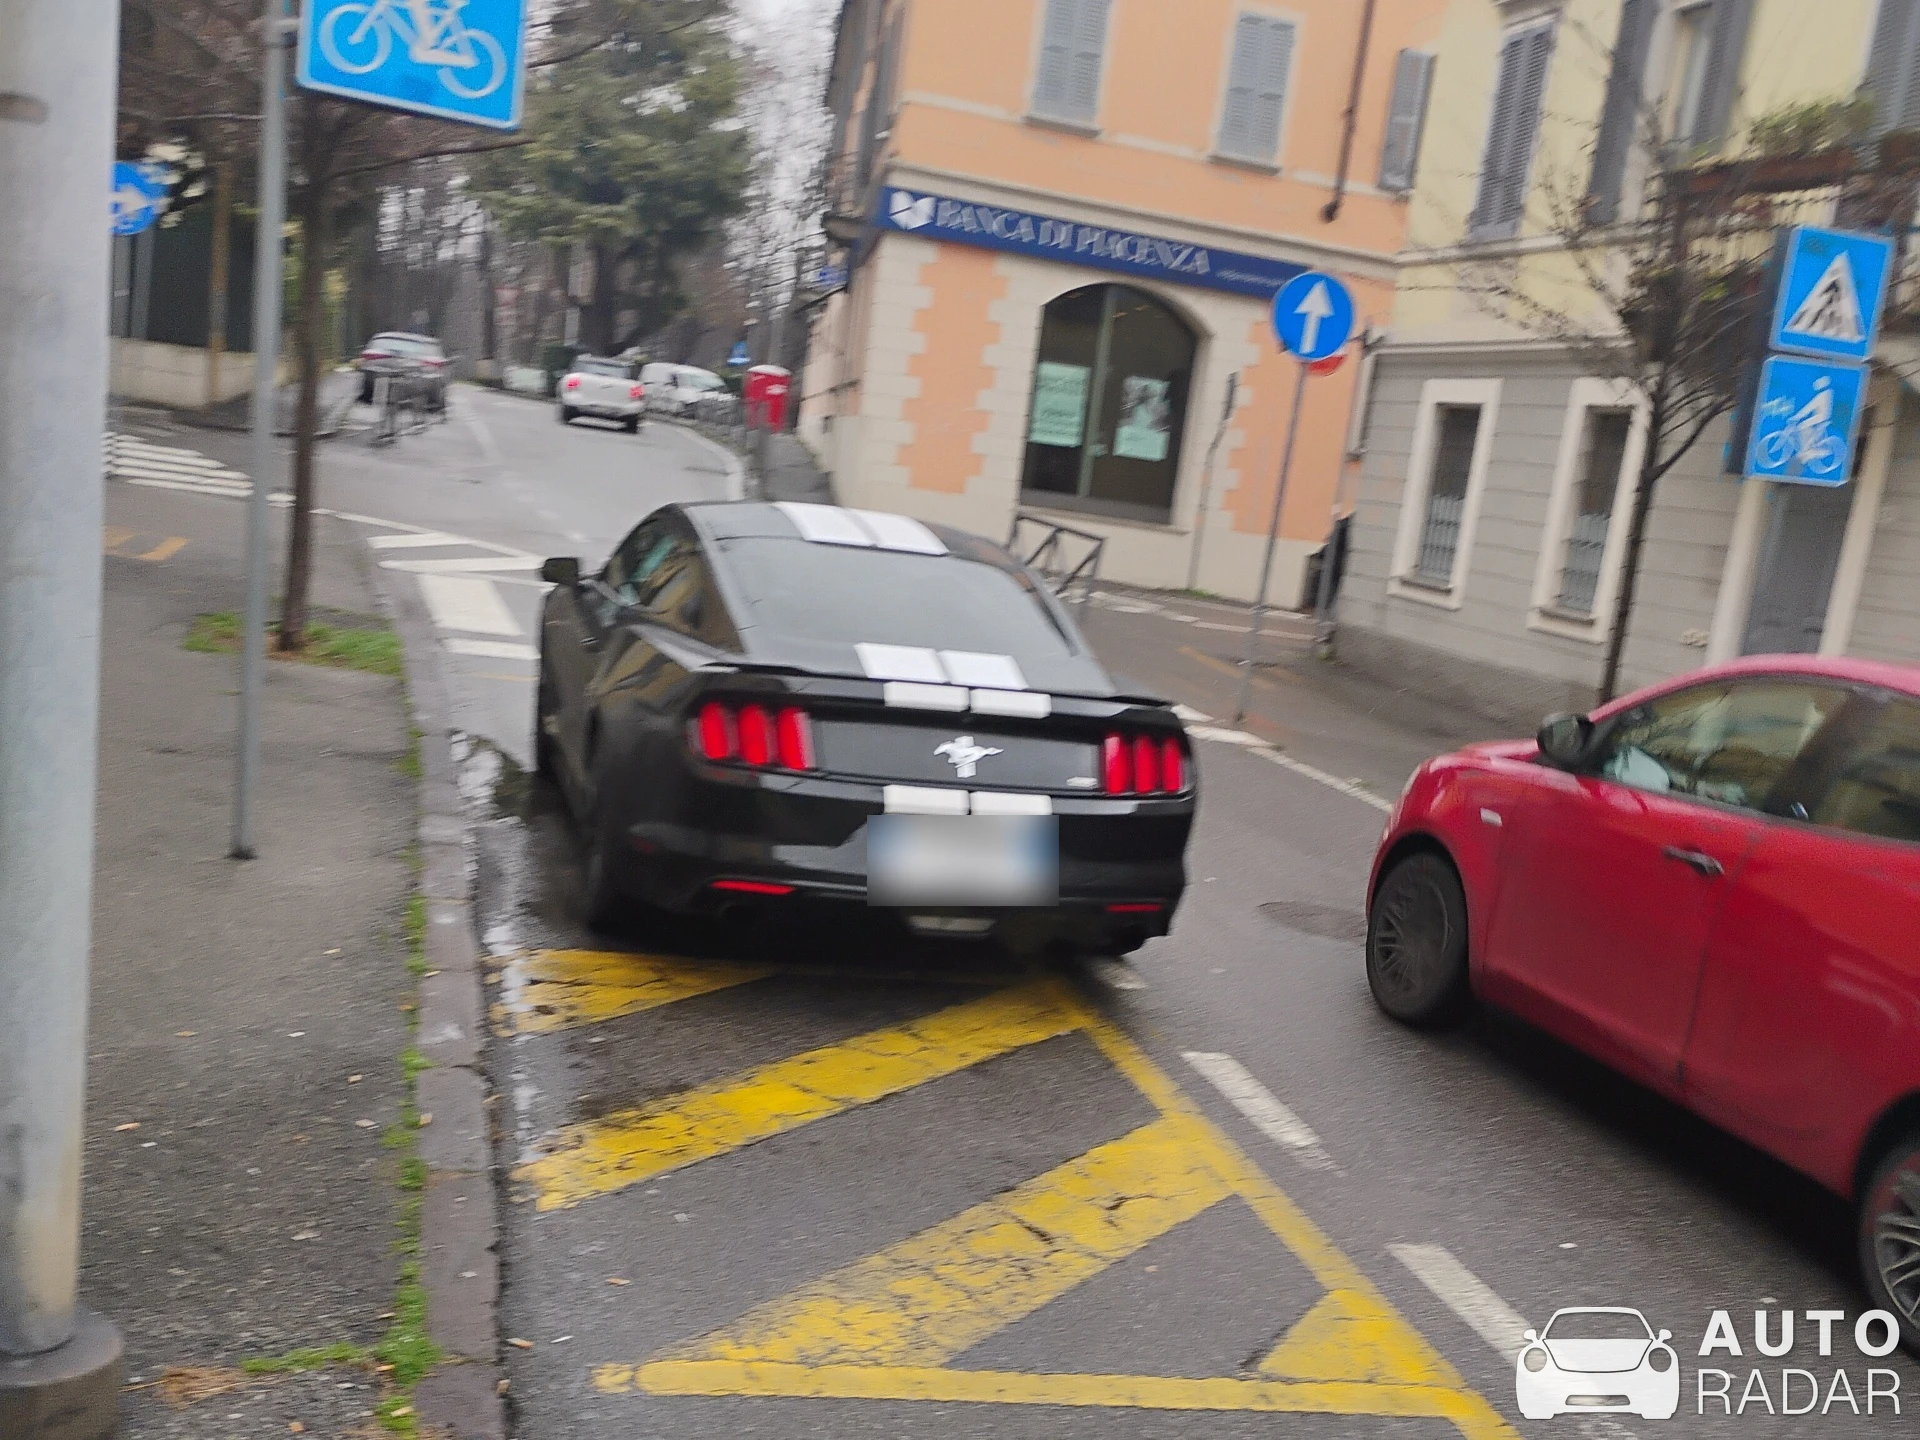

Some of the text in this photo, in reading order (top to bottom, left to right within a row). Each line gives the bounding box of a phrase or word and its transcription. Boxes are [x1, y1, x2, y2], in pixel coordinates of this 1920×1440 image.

[936, 200, 1211, 275] BANCA DI PIACENZA
